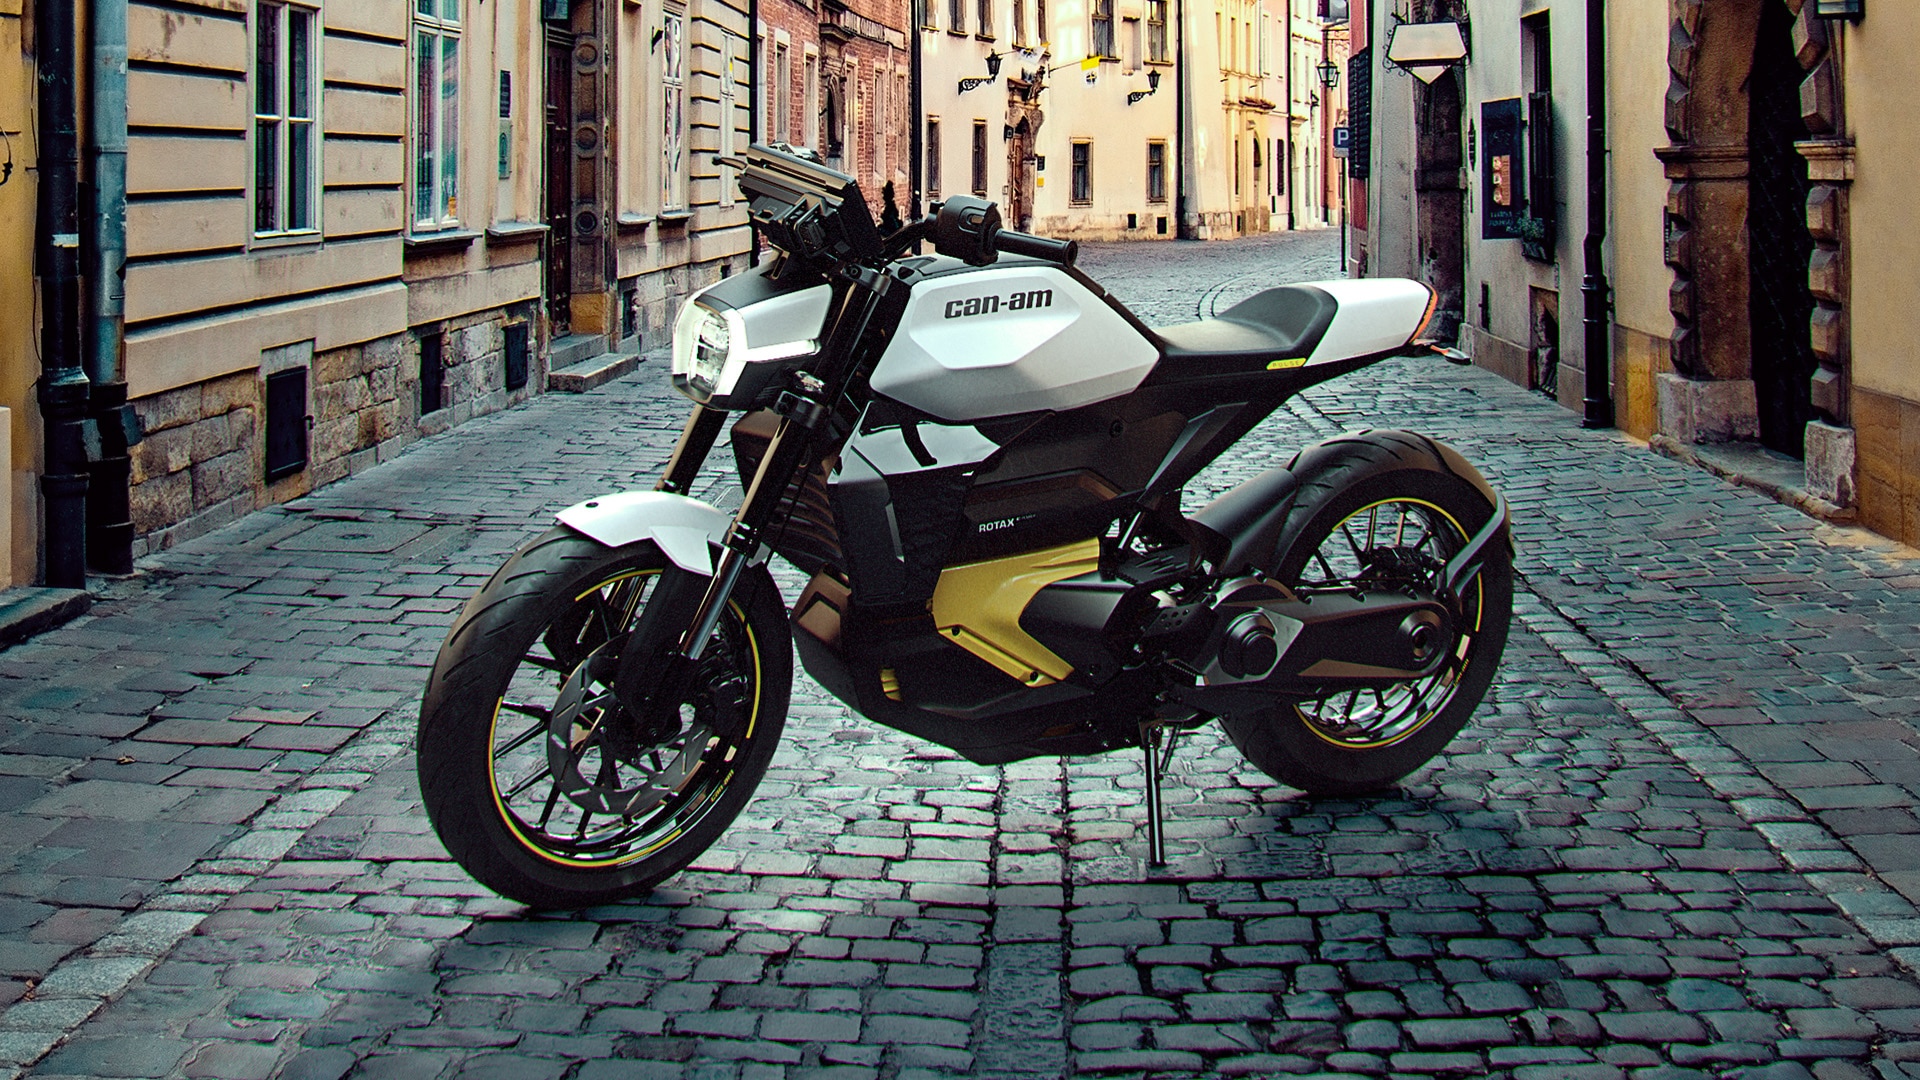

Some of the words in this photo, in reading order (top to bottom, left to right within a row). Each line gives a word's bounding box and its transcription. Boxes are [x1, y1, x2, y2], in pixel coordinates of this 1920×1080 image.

[1337, 129, 1349, 145] P
[944, 289, 1053, 319] can-am
[978, 518, 1015, 533] ROTAX
